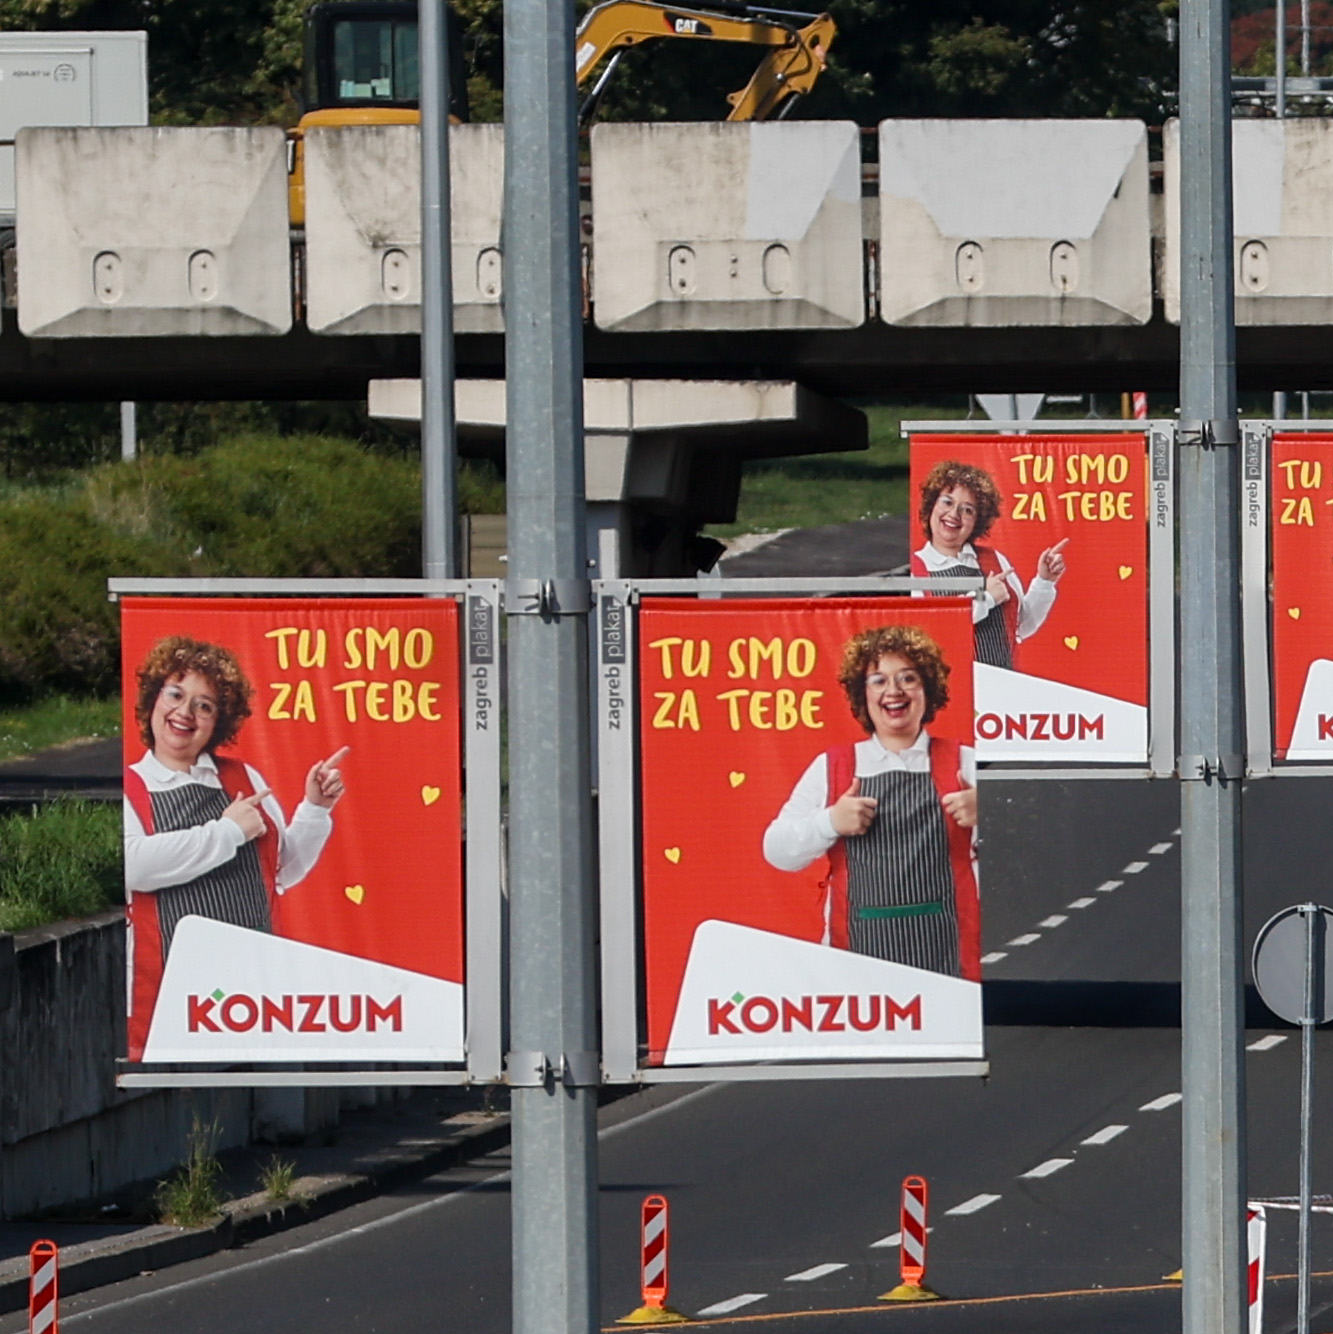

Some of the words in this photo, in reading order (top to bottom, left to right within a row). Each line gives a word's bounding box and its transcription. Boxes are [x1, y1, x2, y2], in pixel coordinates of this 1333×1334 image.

[675, 18, 698, 33] CAT
[1010, 454, 1054, 484] TU
[1065, 453, 1129, 485] SMO
[1278, 460, 1322, 490] TU
[1012, 491, 1047, 522] ZA
[1058, 491, 1134, 522] TEBE
[1154, 482, 1168, 528] zagreb
[1246, 482, 1260, 527] zagreb
[1280, 496, 1314, 527] ZA
[265, 627, 328, 670] TU
[345, 627, 434, 670] SMO
[471, 606, 491, 658] plakat
[604, 605, 623, 658] plakat
[649, 637, 711, 678] TU
[729, 638, 818, 679] SMO
[268, 682, 317, 723] ZA
[334, 681, 441, 723] TEBE
[472, 666, 492, 731] zagreb
[604, 666, 624, 731] zagreb
[652, 690, 700, 731] ZA
[717, 689, 825, 731] TEBE
[975, 713, 1104, 740] ONZUM
[187, 995, 403, 1032] KONZUM
[708, 995, 921, 1034] KONZUM
